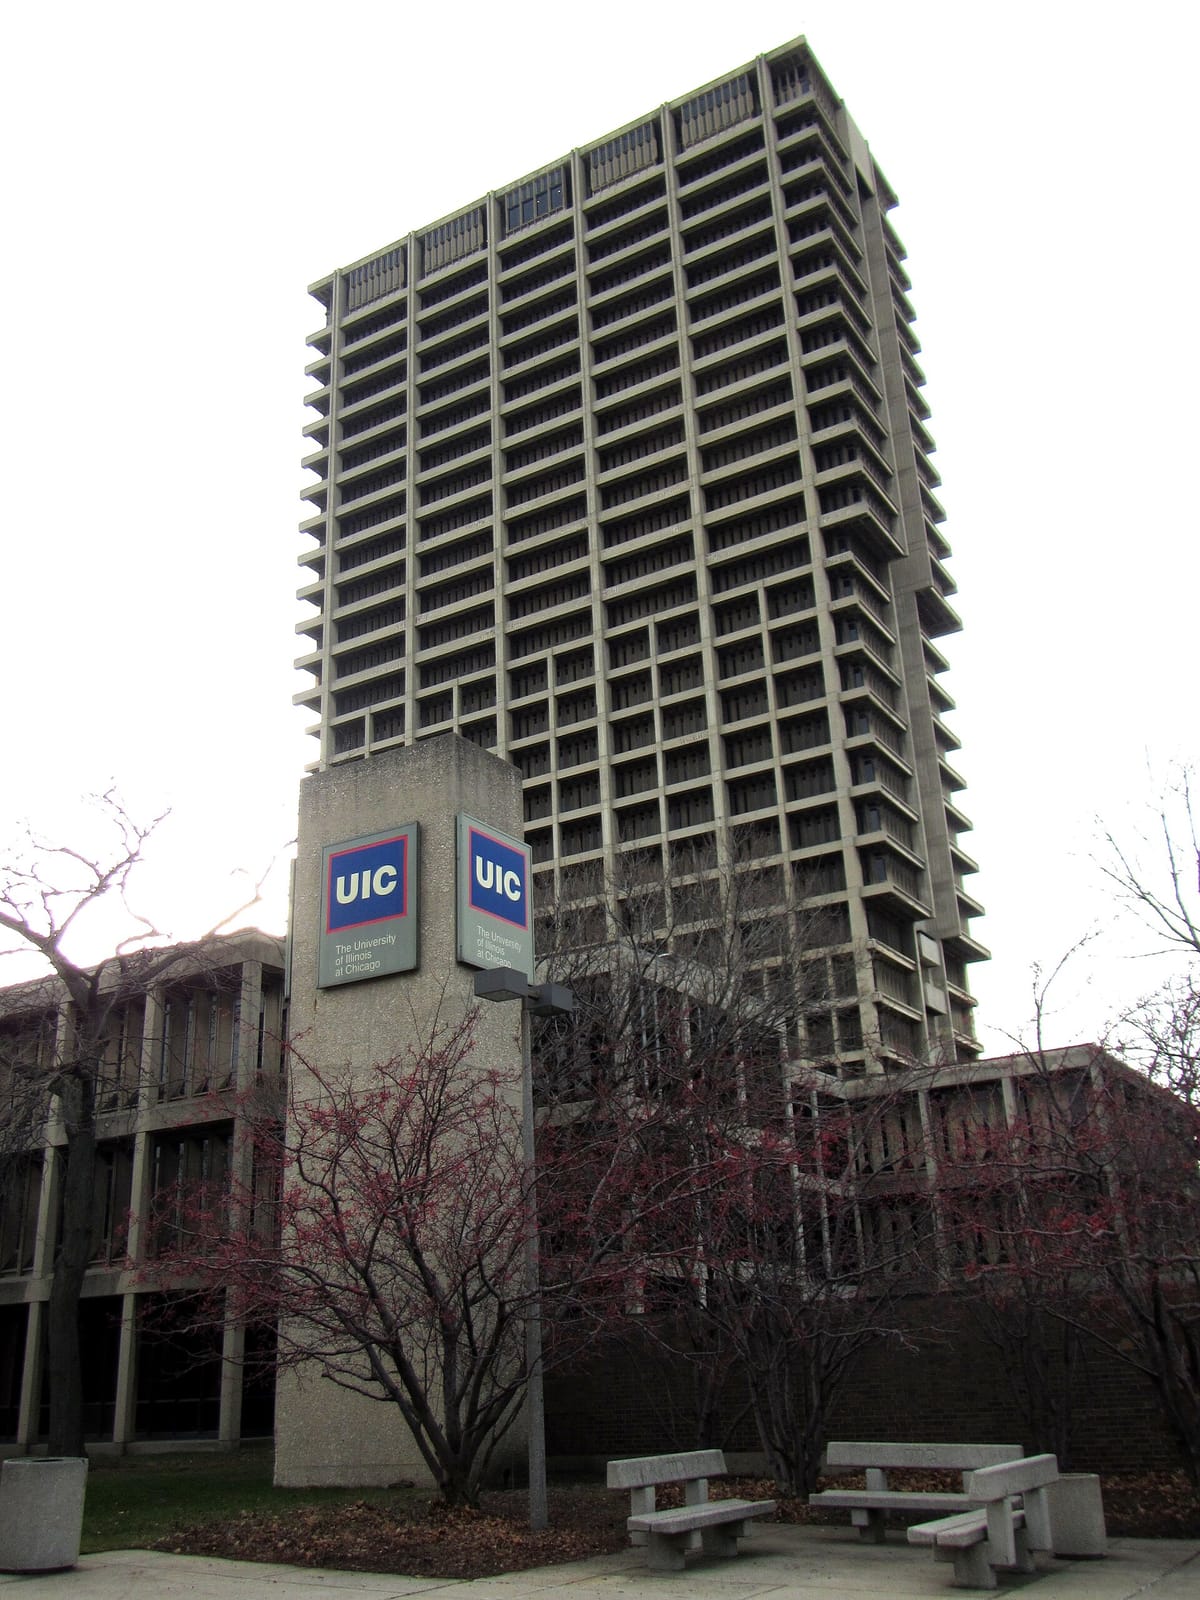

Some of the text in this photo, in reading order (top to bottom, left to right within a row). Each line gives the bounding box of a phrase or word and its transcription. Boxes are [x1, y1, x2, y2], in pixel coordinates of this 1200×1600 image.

[336, 865, 397, 905] UIC
[476, 855, 521, 901] UIC
[335, 934, 396, 954] The University
[476, 938, 505, 956] of Illinois
[477, 925, 521, 953] The University
[335, 950, 372, 966] of Illinois
[476, 949, 484, 959] at
[335, 960, 381, 977] at Chicago
